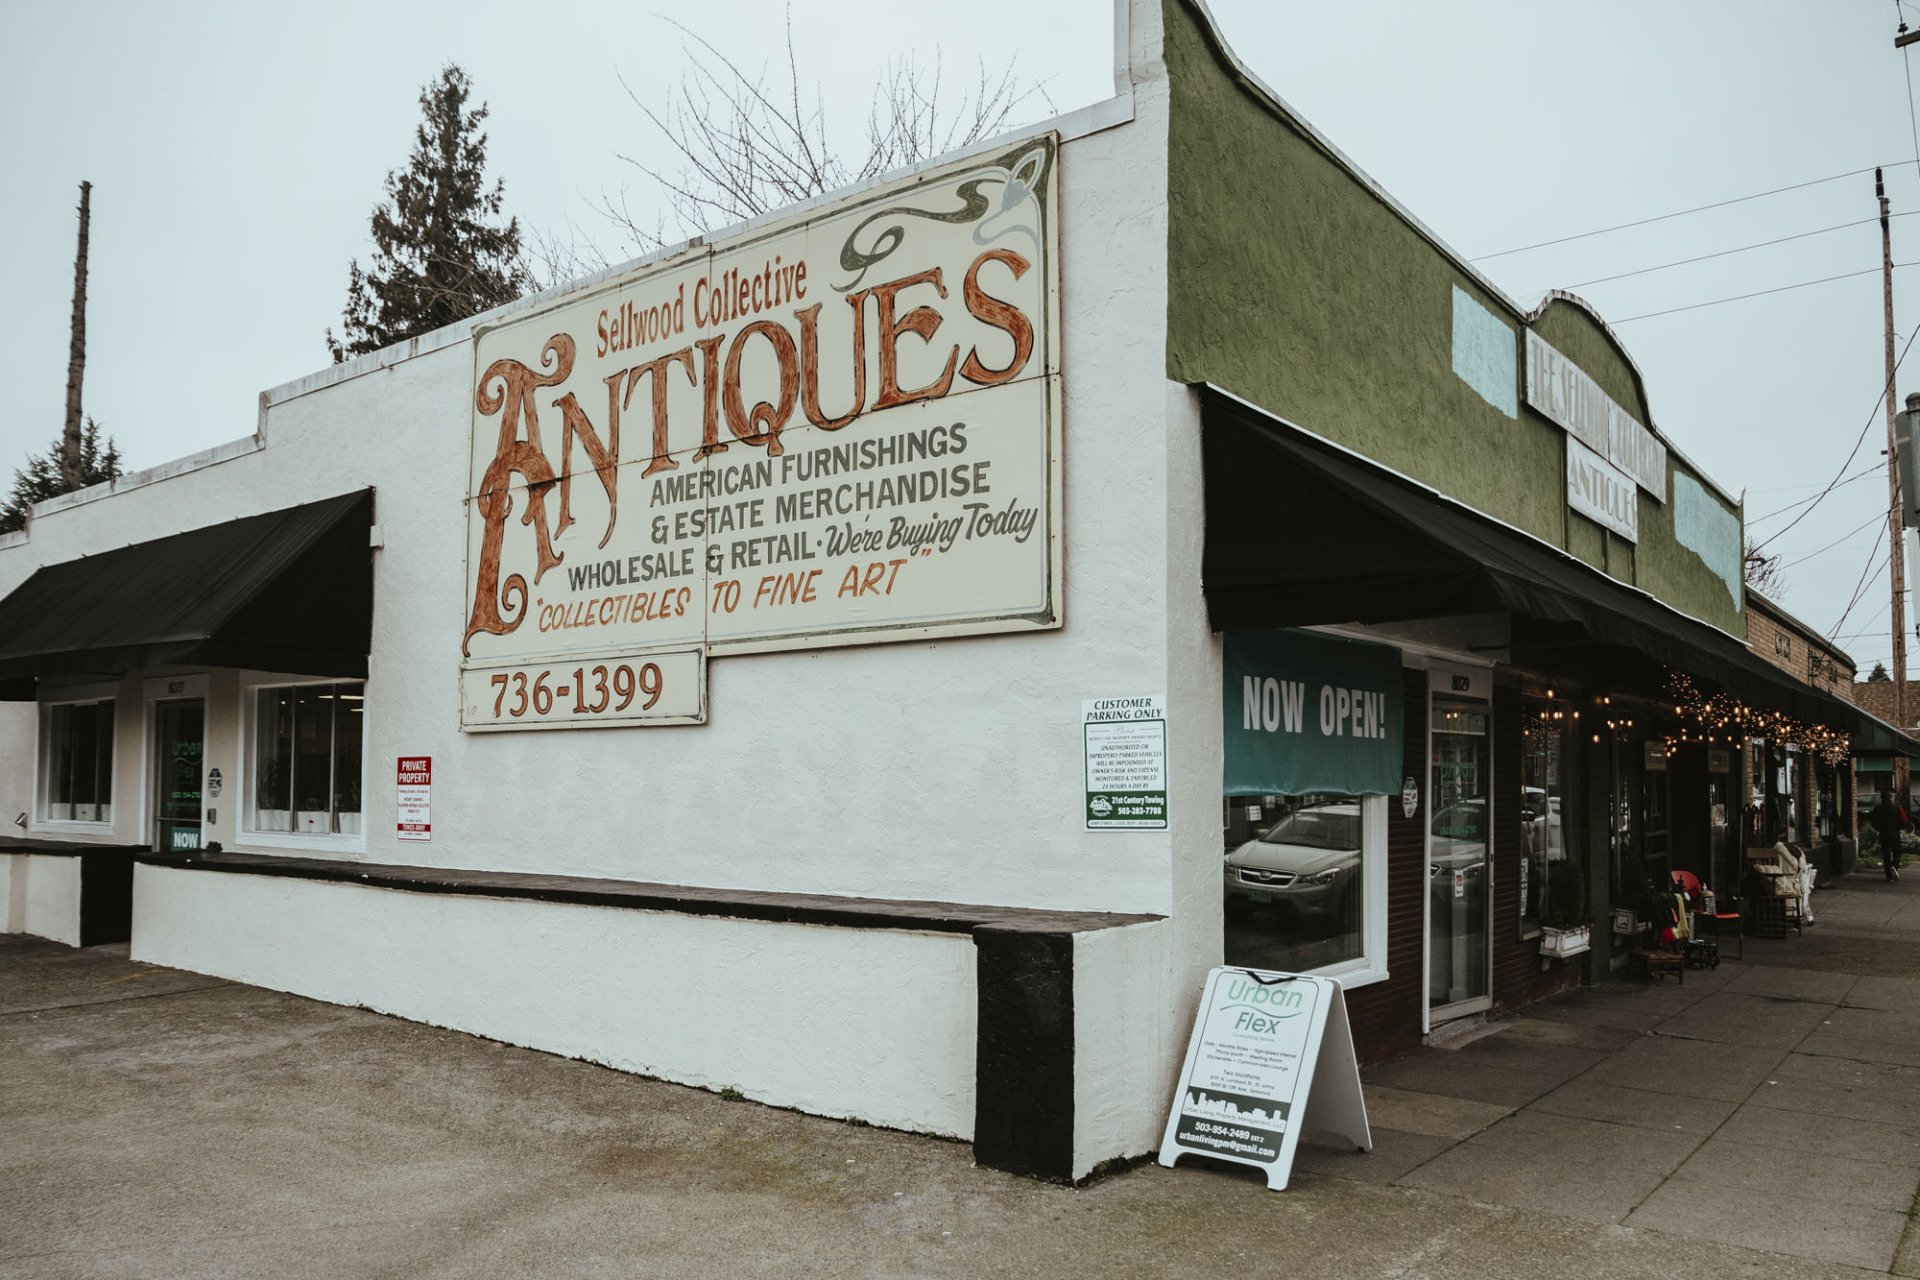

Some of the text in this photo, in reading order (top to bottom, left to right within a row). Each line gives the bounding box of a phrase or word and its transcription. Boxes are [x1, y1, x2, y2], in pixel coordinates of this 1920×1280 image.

[597, 255, 808, 358] Sellwood Collective
[464, 248, 1035, 658] ANTIQUES
[650, 421, 969, 508] AMERICAN FURNISHINGS
[650, 460, 992, 545] & ESTATE MERCHANDISE
[568, 544, 695, 593] WHOLESALE
[706, 543, 724, 576] &
[887, 510, 960, 555] Buying
[962, 496, 1039, 545] Today
[712, 579, 742, 613] TO
[754, 568, 824, 609] FINE
[491, 662, 664, 719] 736-1399
[1094, 698, 1152, 710] CUSTOMER
[1086, 708, 1162, 721] PARKING ONLY
[1243, 675, 1386, 739] NOW OPEN!
[398, 772, 430, 783] PROPERTY
[402, 761, 426, 771] PRIVATE
[1123, 796, 1145, 805] Century
[1144, 795, 1164, 806] Towing
[174, 832, 199, 848] NOW
[1227, 979, 1304, 1009] Urban
[1234, 1011, 1281, 1035] Flex
[1194, 1121, 1250, 1140] 503-954-2489
[1179, 1132, 1275, 1157] urbanlivingpm@gmail.com
